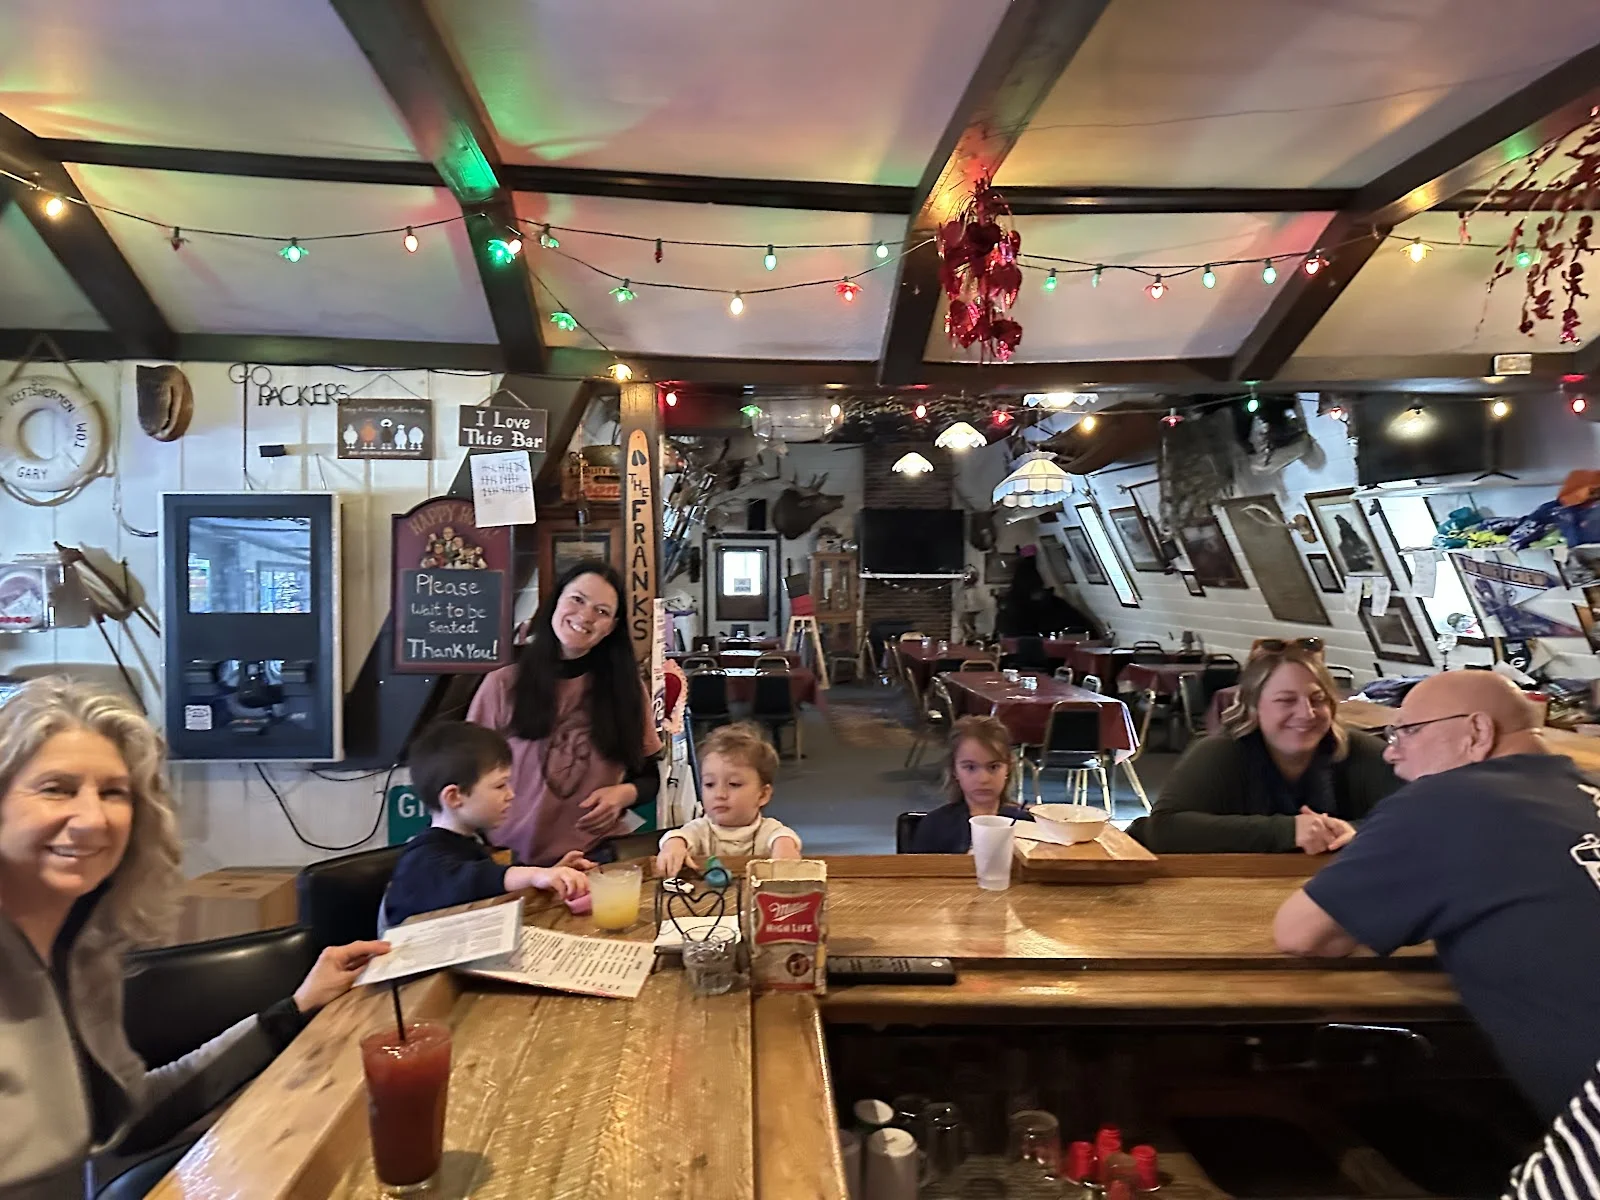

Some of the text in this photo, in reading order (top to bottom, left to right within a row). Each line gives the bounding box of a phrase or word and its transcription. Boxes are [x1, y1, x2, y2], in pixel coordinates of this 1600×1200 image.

[229, 363, 272, 386] GO
[258, 383, 350, 406] PACKERS
[475, 410, 531, 430] I Love
[74, 422, 87, 448] TOM
[462, 427, 543, 448] This Bar
[17, 466, 48, 479] GARY
[628, 473, 650, 498] THE
[410, 503, 458, 536] HAPPY
[632, 500, 649, 641] FRANKS
[416, 573, 482, 596] Please
[446, 602, 464, 618] to
[467, 604, 488, 619] be
[765, 924, 813, 933] HIGH LIFE
